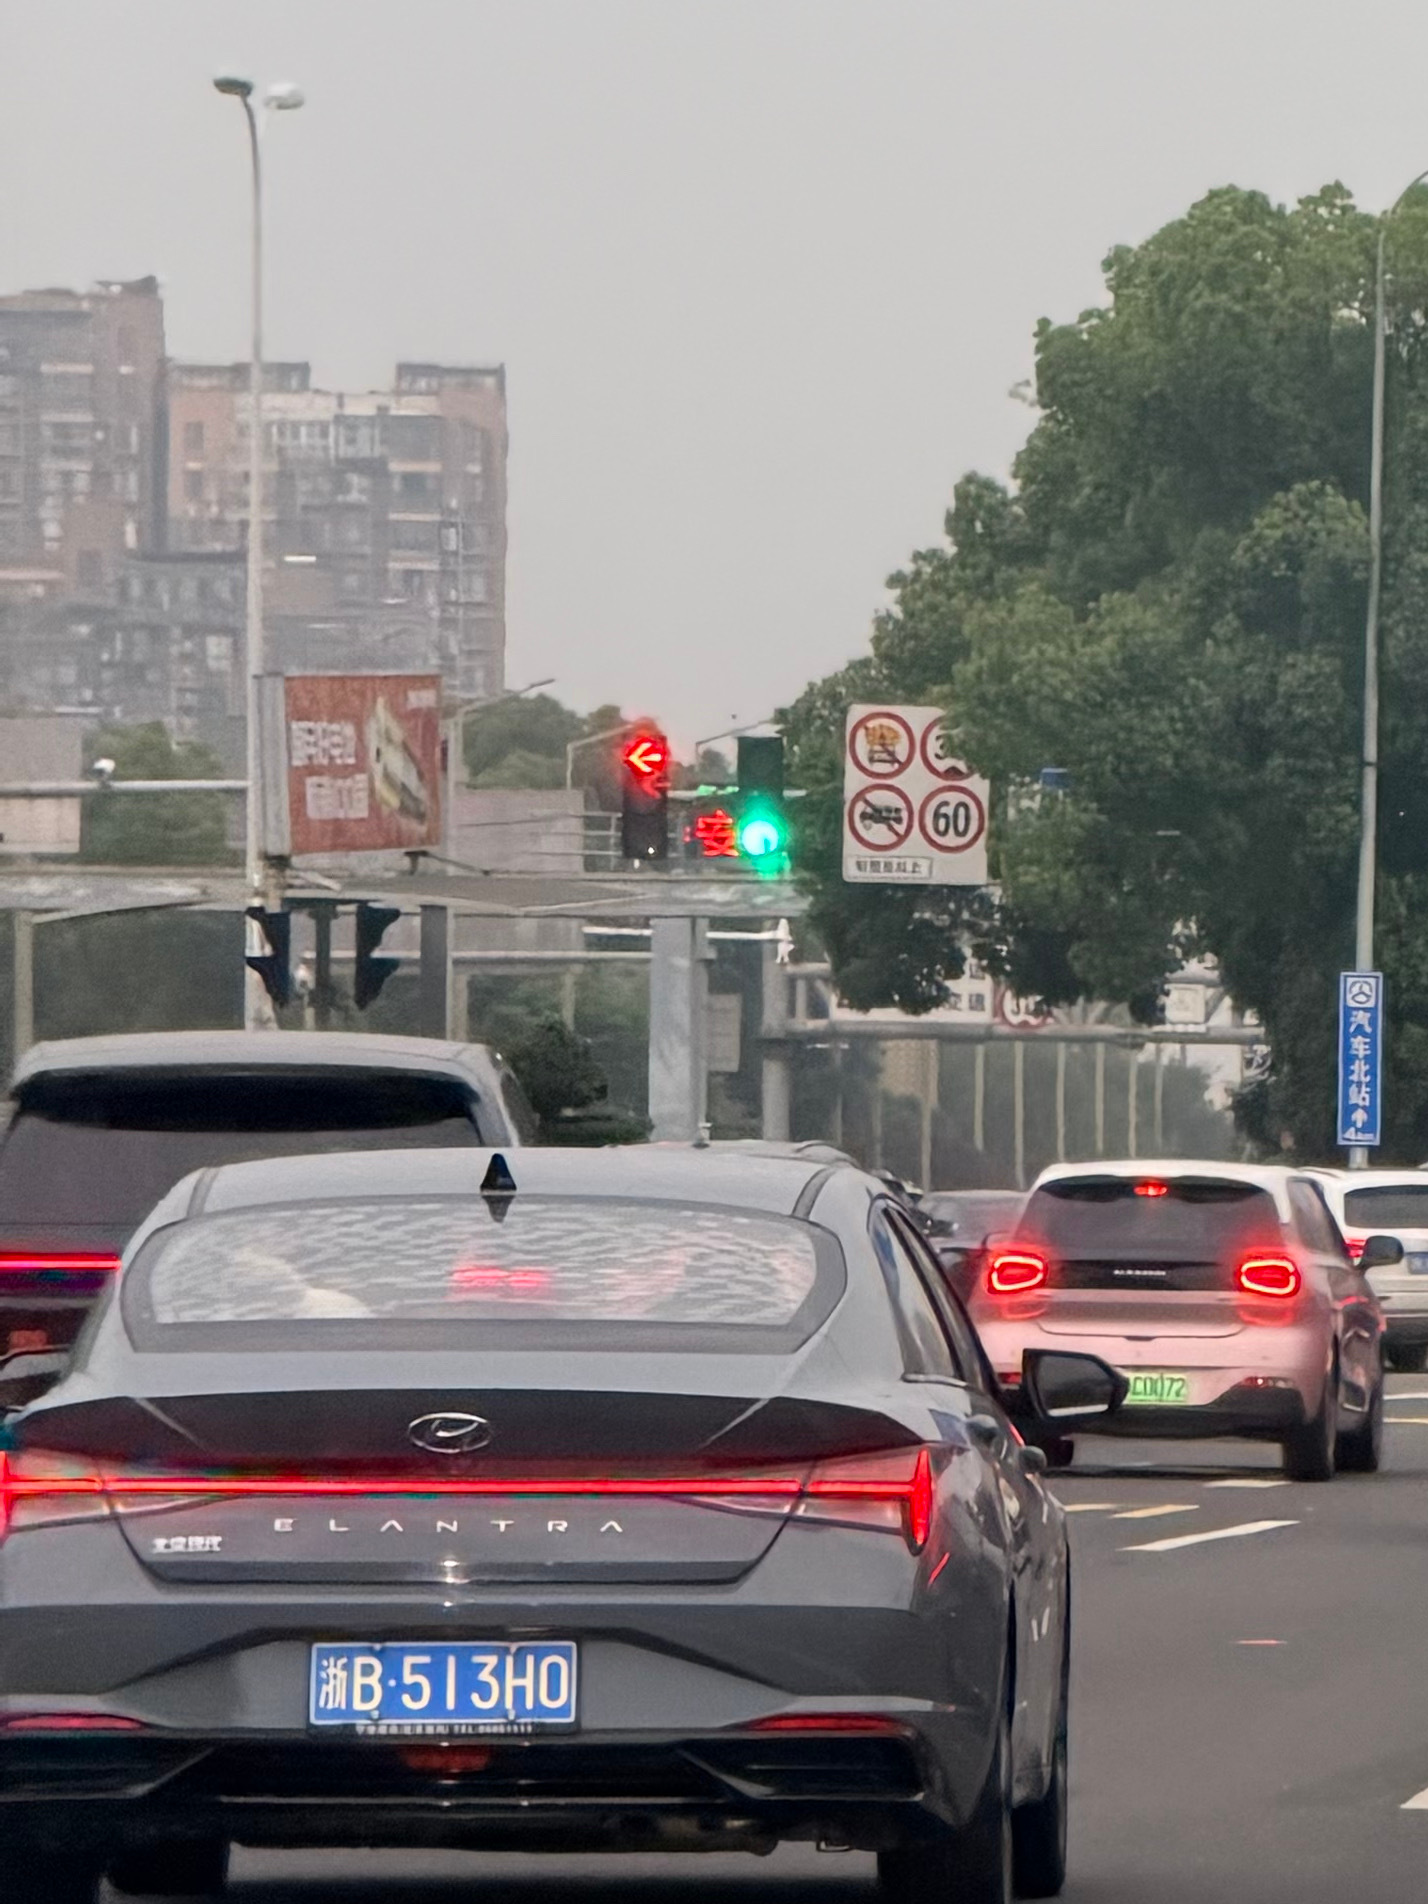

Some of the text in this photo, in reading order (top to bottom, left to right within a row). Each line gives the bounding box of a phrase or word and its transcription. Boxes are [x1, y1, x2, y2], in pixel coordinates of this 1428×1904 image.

[932, 800, 972, 839] 60
[1349, 1009, 1373, 1107] 汽车北站
[273, 1518, 624, 1533] ELANTRA
